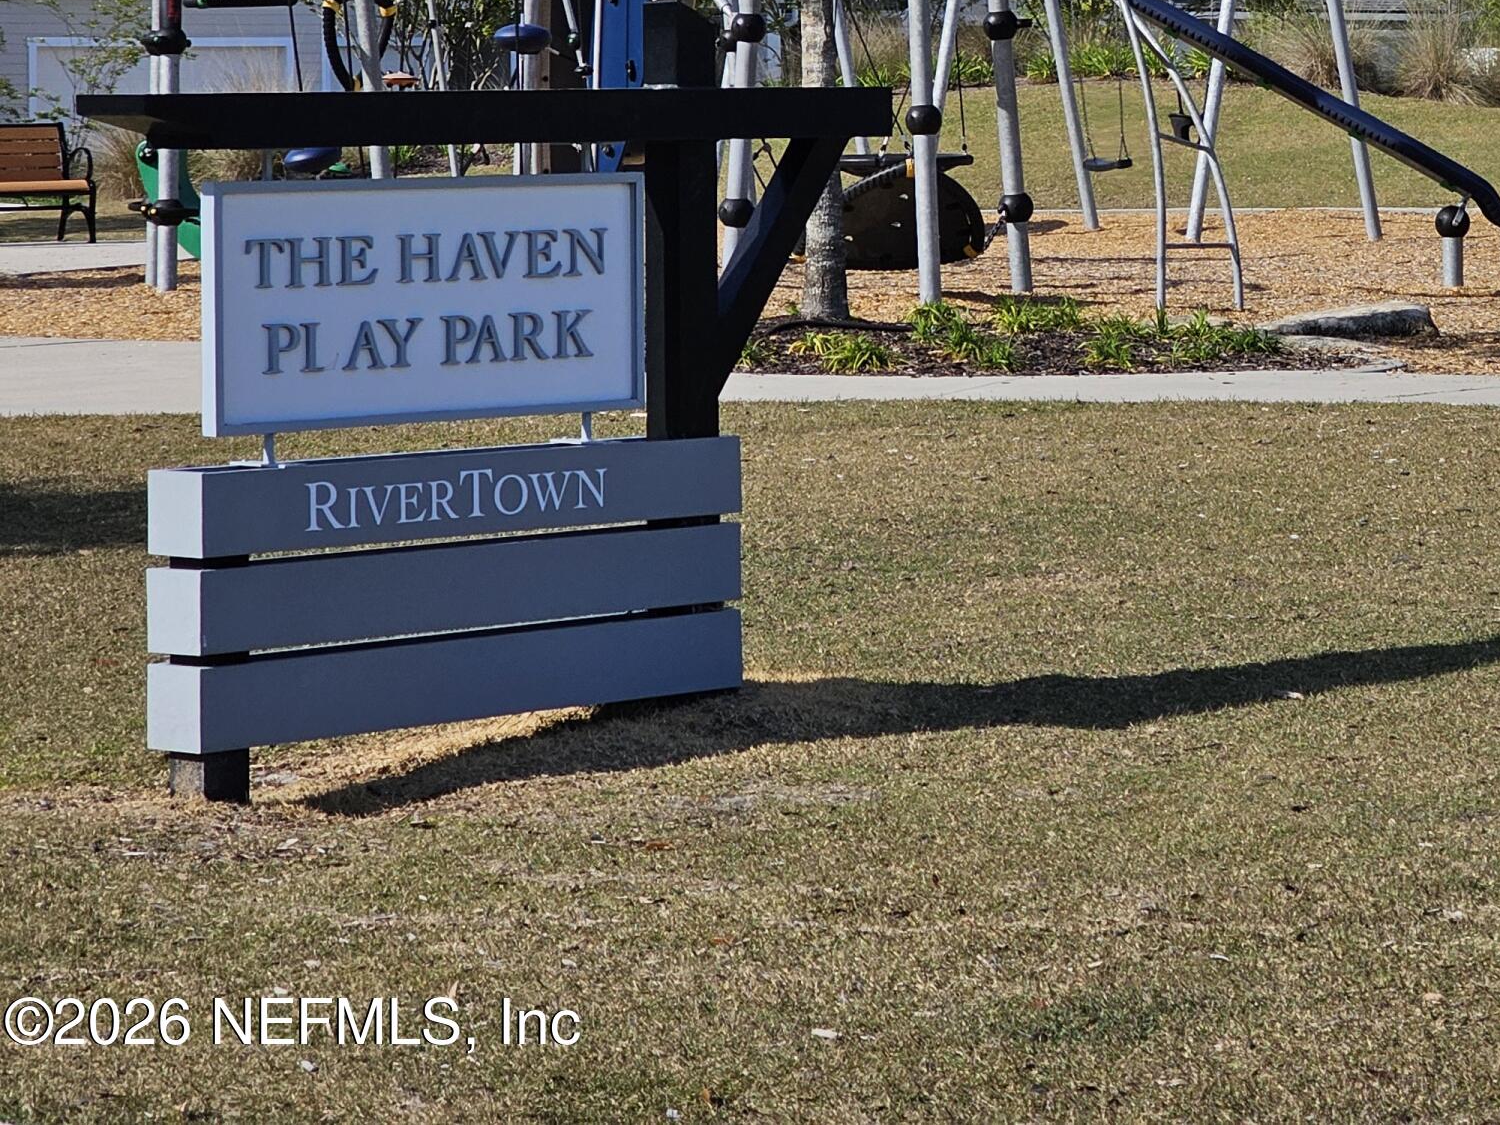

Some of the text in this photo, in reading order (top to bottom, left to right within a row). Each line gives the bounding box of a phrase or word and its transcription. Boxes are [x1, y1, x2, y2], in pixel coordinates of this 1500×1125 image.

[244, 227, 608, 290] THE HAVEN
[261, 309, 595, 375] PLAY PARK
